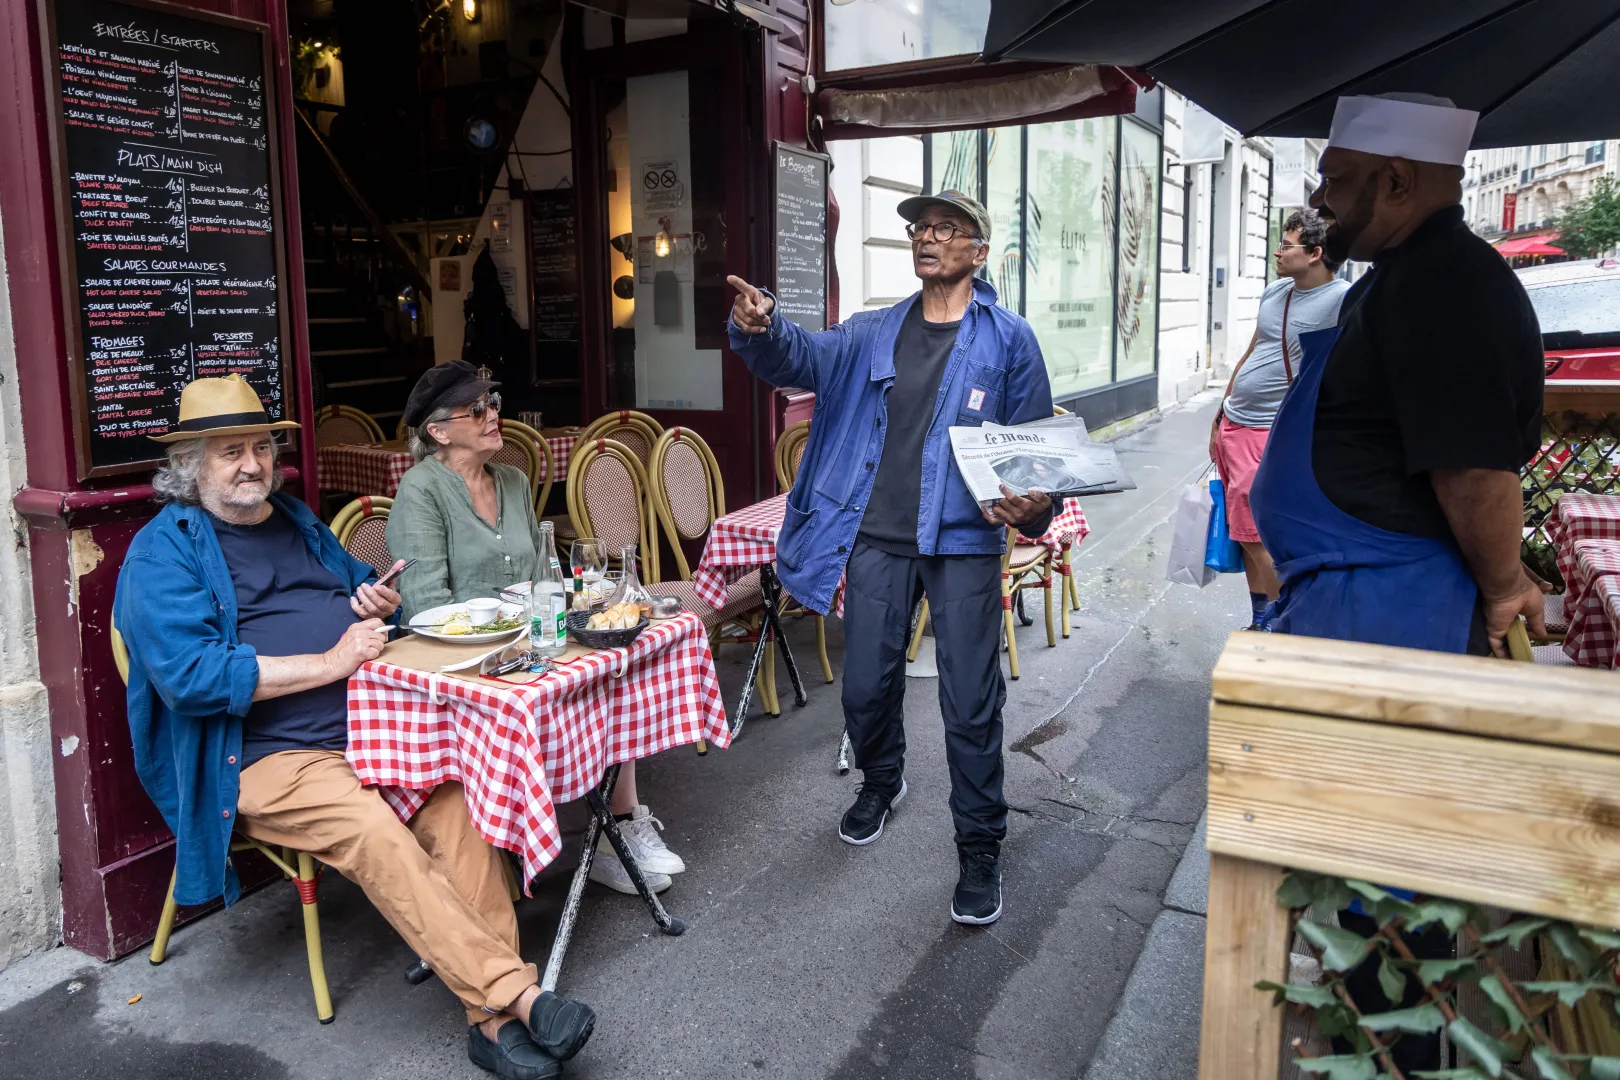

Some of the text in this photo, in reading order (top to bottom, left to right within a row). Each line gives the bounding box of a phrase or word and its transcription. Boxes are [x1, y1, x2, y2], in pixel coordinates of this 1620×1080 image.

[161, 35, 219, 53] STARTERS
[60, 53, 82, 61] LENTILS
[86, 55, 90, 63] &
[63, 44, 96, 55] LENTILLES
[111, 54, 136, 63] SAUMON
[64, 63, 95, 75] POIREAU
[96, 93, 137, 107] MAYONNAISE
[69, 110, 94, 120] SALADE
[75, 172, 105, 181] BAVETTE
[190, 183, 215, 192] BURGER
[77, 192, 111, 200] TARTARE
[125, 195, 148, 203] BOEUF
[191, 215, 227, 224] ENTRECÔTE
[104, 258, 226, 271] SALADES GOURMANDES
[86, 279, 111, 287] SALADE
[213, 332, 253, 342] DESSERTS
[91, 336, 144, 350] FROMAGES
[90, 350, 145, 360] BRIE DE MEAUX
[98, 404, 124, 412] CANTAL
[98, 408, 152, 420] CANTAL CHEESE
[99, 423, 117, 431] DUO
[132, 418, 169, 428] FROMAGES
[100, 431, 116, 439] TWO
[148, 427, 169, 435] CHEESE
[984, 432, 998, 445] Le
[998, 432, 1048, 444] Monde
